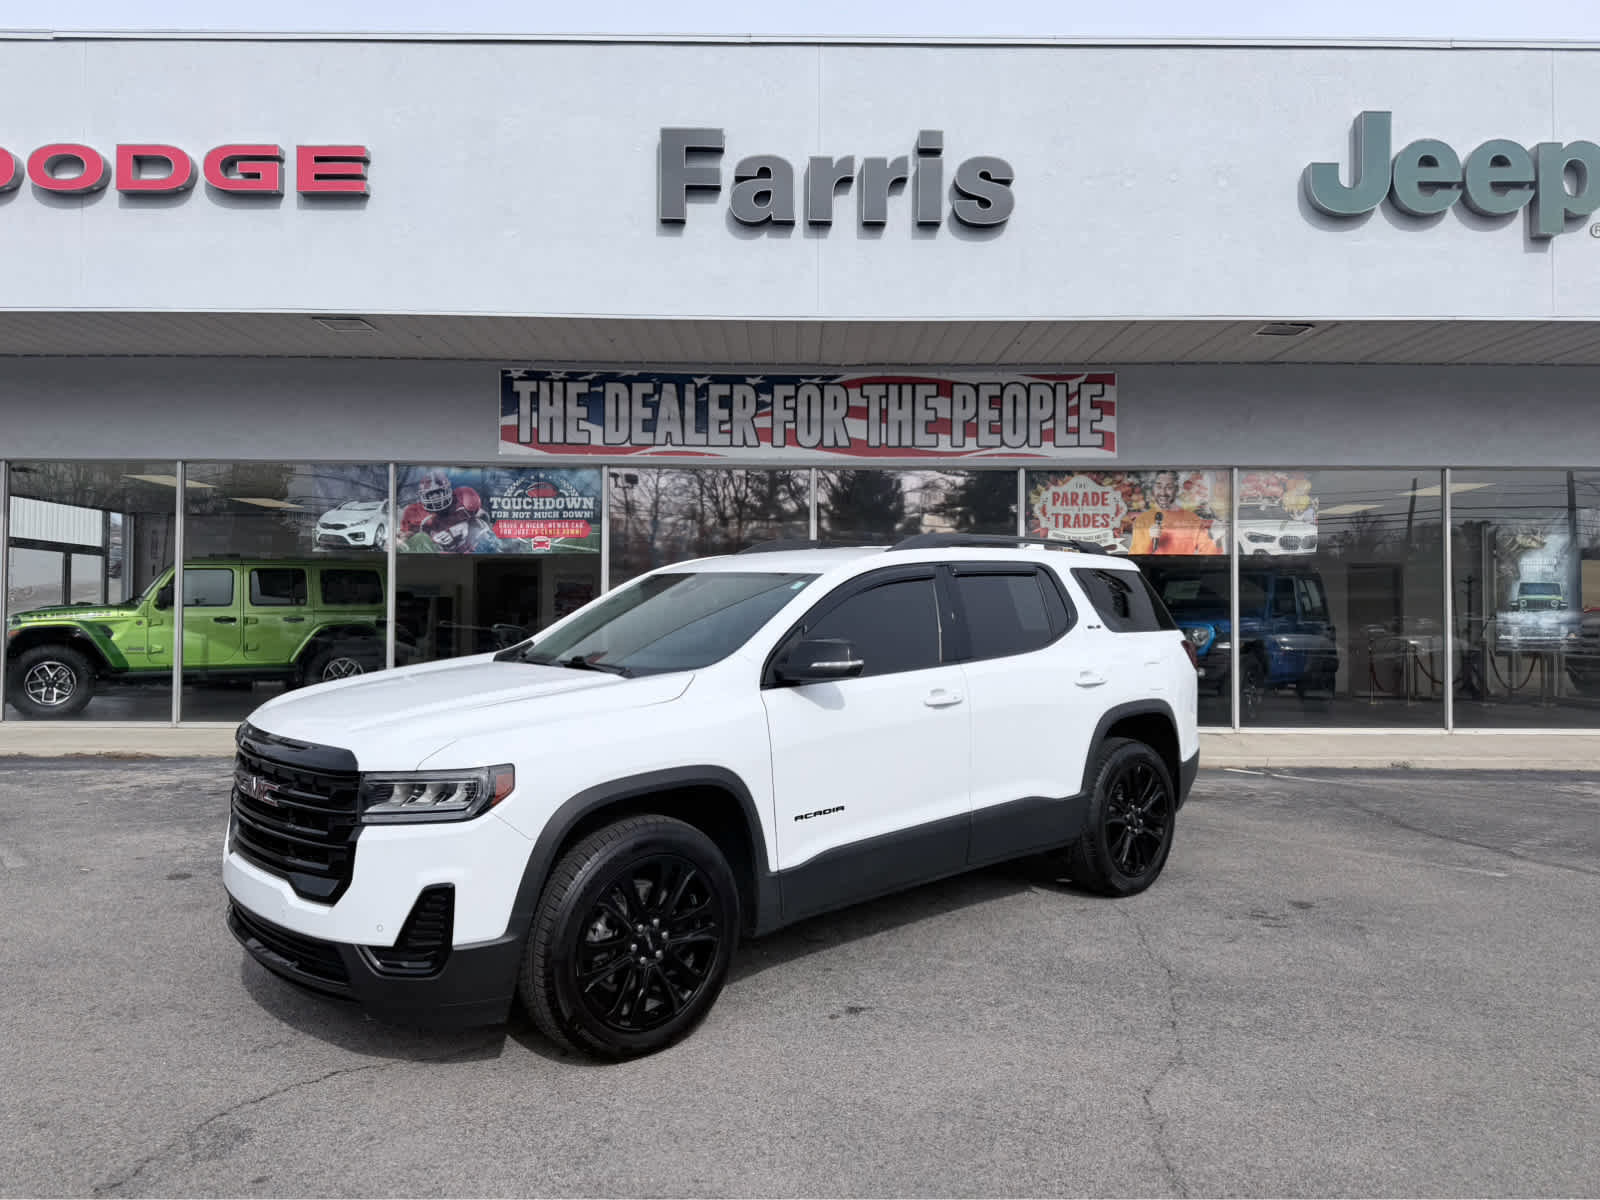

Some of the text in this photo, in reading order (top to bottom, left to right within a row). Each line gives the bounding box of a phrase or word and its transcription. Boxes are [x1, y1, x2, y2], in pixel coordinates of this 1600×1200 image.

[0, 143, 370, 198] ODGE
[657, 127, 1015, 228] Farris
[1302, 111, 1600, 241] Jeep
[512, 379, 1104, 449] THE DEALER FOR THE PEOPLE
[489, 497, 595, 510] TOUCHDOWN
[1052, 491, 1110, 507] PARADE
[491, 511, 594, 519] FOR NOT MUCH DOWN!
[1051, 513, 1111, 529] TRADES
[794, 805, 845, 822] ACADIA
